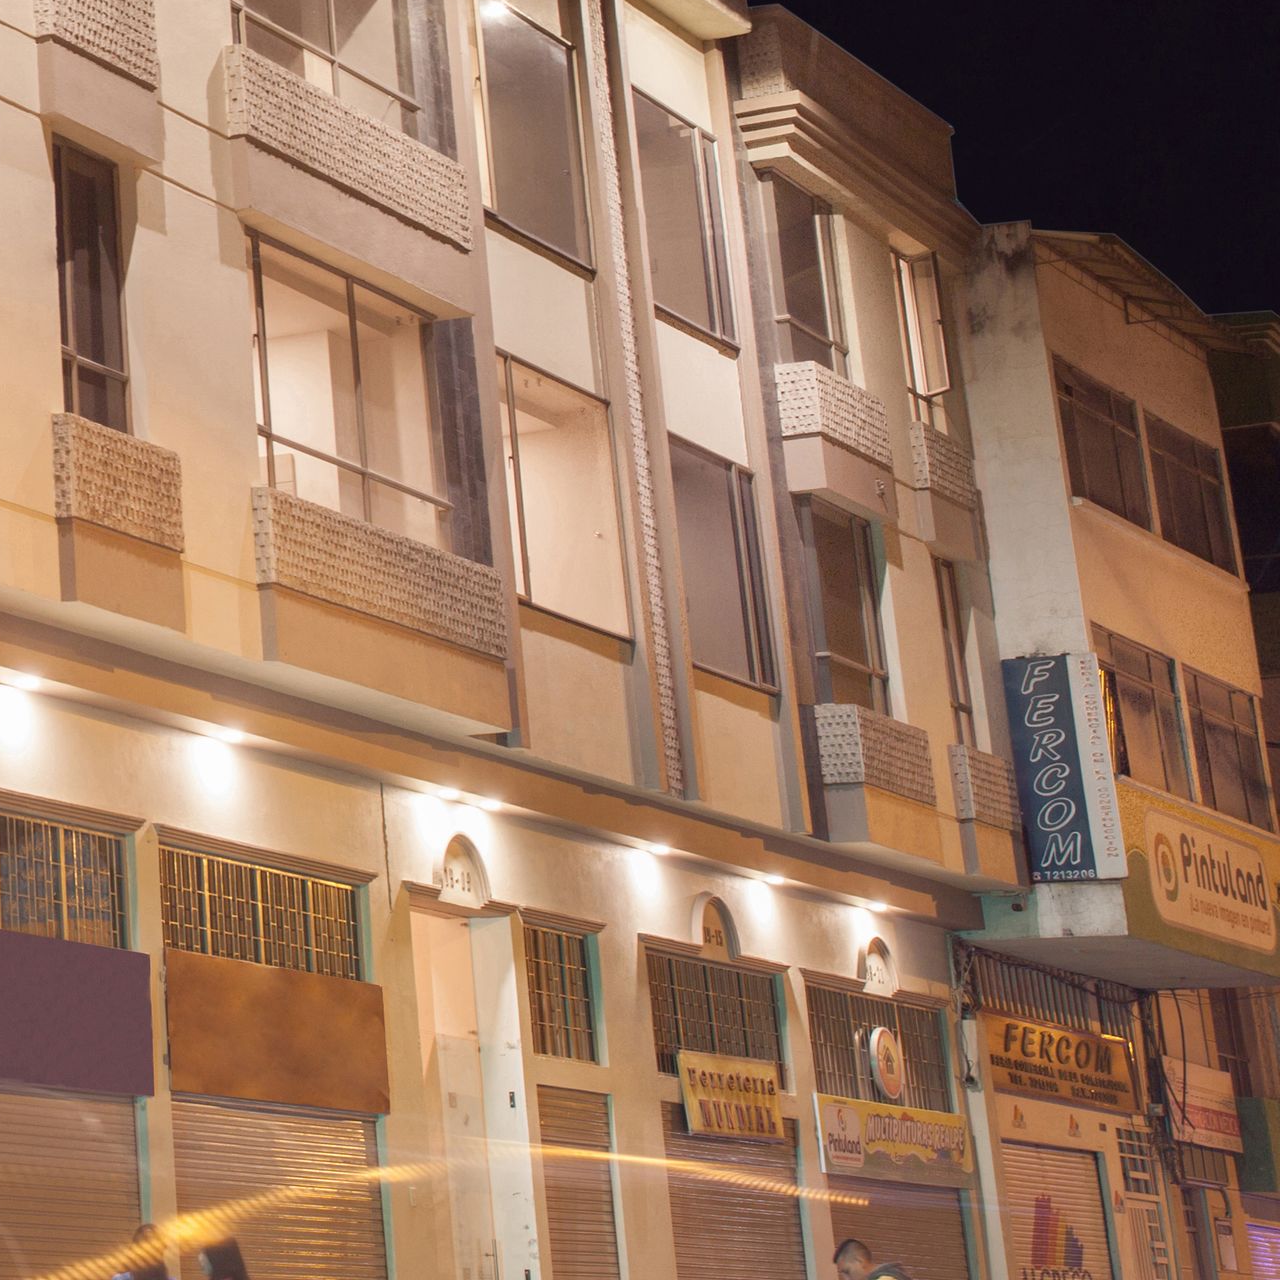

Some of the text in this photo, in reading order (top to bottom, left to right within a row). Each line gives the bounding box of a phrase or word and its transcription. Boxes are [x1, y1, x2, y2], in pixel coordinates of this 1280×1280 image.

[1021, 660, 1081, 867] FERCOM
[1044, 869, 1096, 881] 7213206
[1180, 832, 1268, 911] Pintuland
[1004, 1023, 1112, 1074] FERCOM
[699, 1099, 777, 1134] MUNDIAL
[865, 1112, 933, 1148] MULTIPINTURAS
[827, 1132, 861, 1155] Pintuland
